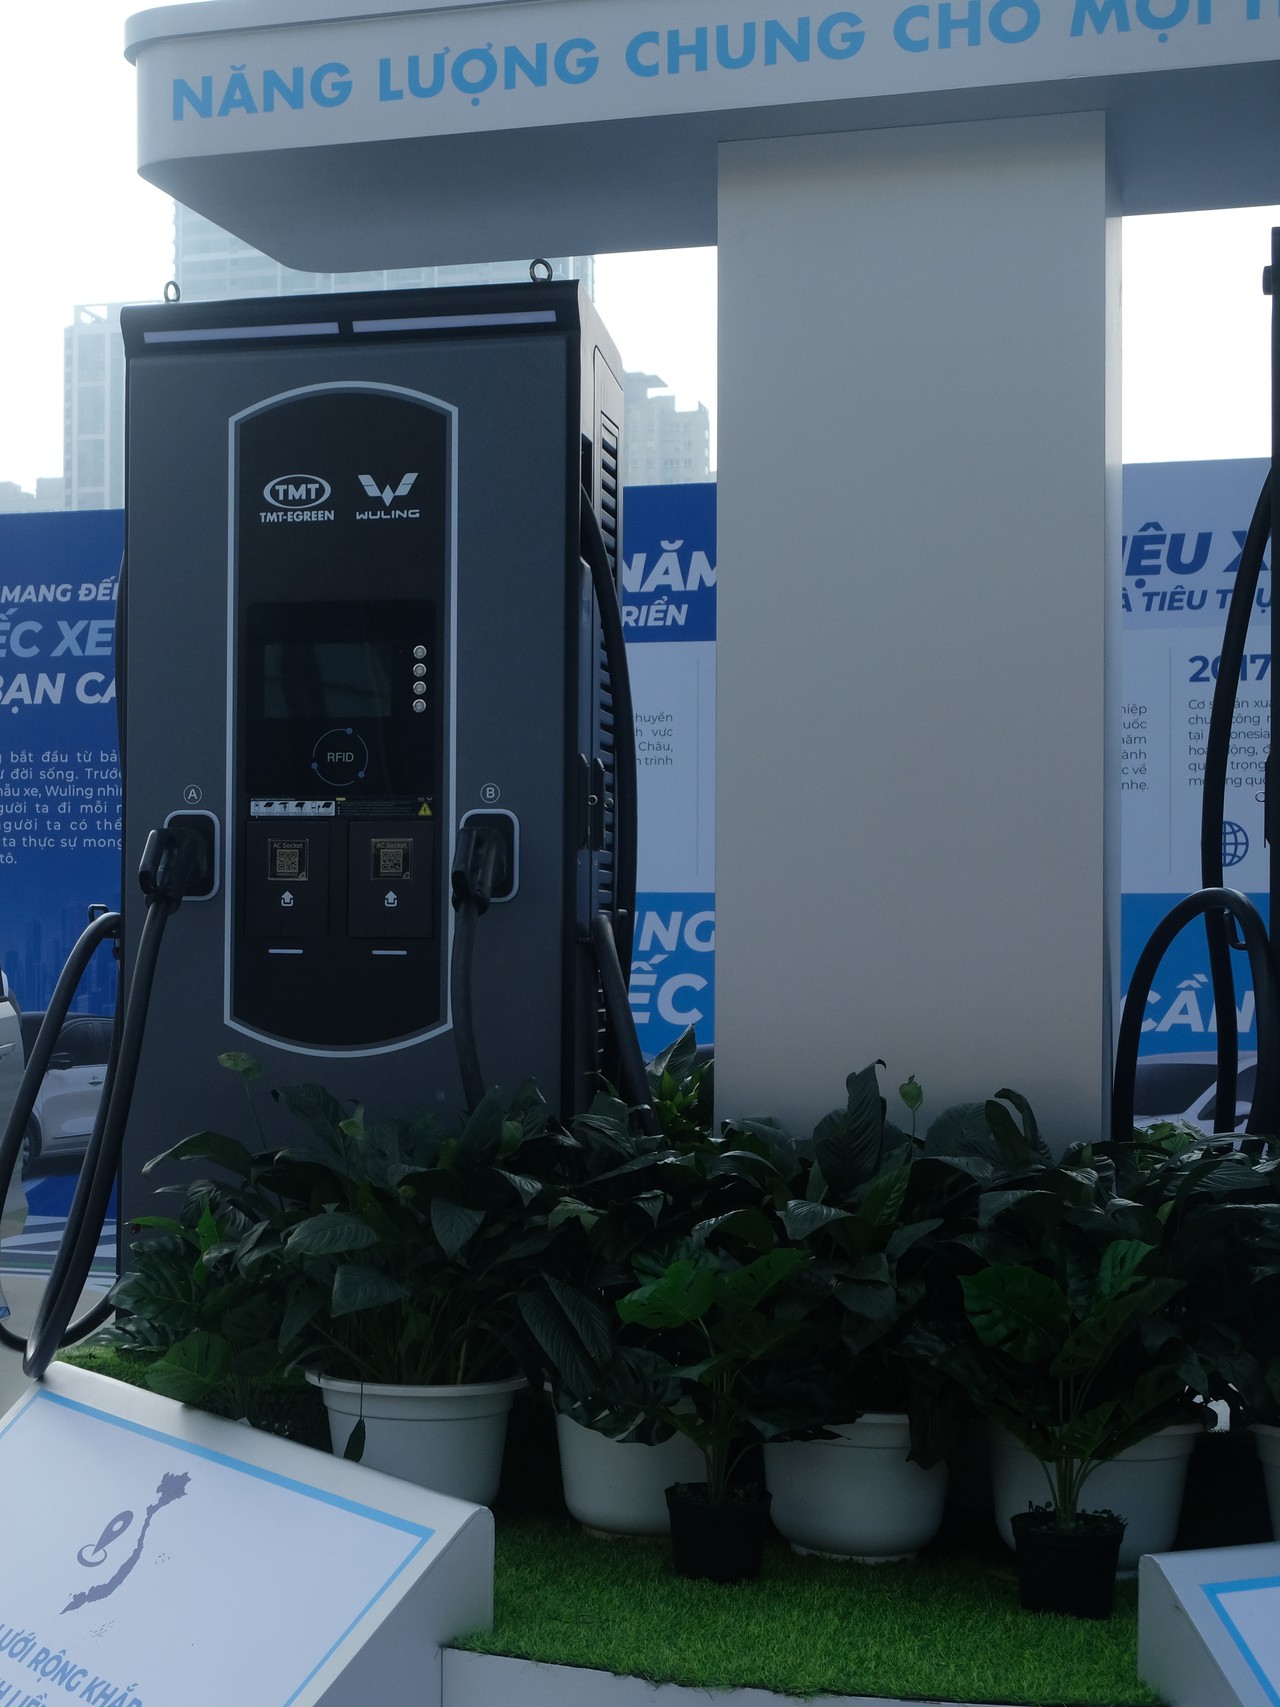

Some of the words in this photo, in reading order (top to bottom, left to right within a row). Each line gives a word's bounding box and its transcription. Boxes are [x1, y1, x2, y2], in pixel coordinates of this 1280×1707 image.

[172, 62, 353, 121] NĂNG
[379, 37, 599, 107] LƯỢNG
[625, 11, 865, 78] CHUNG
[893, 0, 1041, 53] CHO
[275, 483, 320, 501] TMT
[259, 510, 335, 523] TMT-EGREEN
[356, 509, 420, 520] WULING
[1122, 521, 1213, 589] ỆU
[0, 584, 72, 603] MANG
[1142, 585, 1208, 612] TIÊU
[1216, 588, 1271, 614] TỤ
[50, 619, 116, 657] XE
[1188, 699, 1205, 710] Cơ
[651, 727, 673, 739] vực
[1188, 729, 1204, 742] tại
[638, 741, 673, 752] Châu,
[10, 750, 33, 763] bắt
[41, 750, 68, 763] đầu
[77, 751, 93, 763] từ
[326, 752, 354, 763] RFID
[645, 755, 673, 766] trình
[10, 768, 33, 780] đời
[39, 767, 79, 782] sống.
[23, 786, 42, 799] xe,
[45, 785, 93, 799] Wuling
[35, 803, 49, 814] ta
[57, 801, 71, 814] đi
[80, 800, 107, 814] mỗi
[46, 820, 61, 831] ta
[69, 818, 88, 831] có
[2, 837, 16, 847] ta
[22, 835, 55, 849] thực
[60, 836, 78, 850] sự
[0, 852, 17, 864] tô.
[634, 910, 716, 952] NG
[26, 1646, 89, 1692] RỘNG
